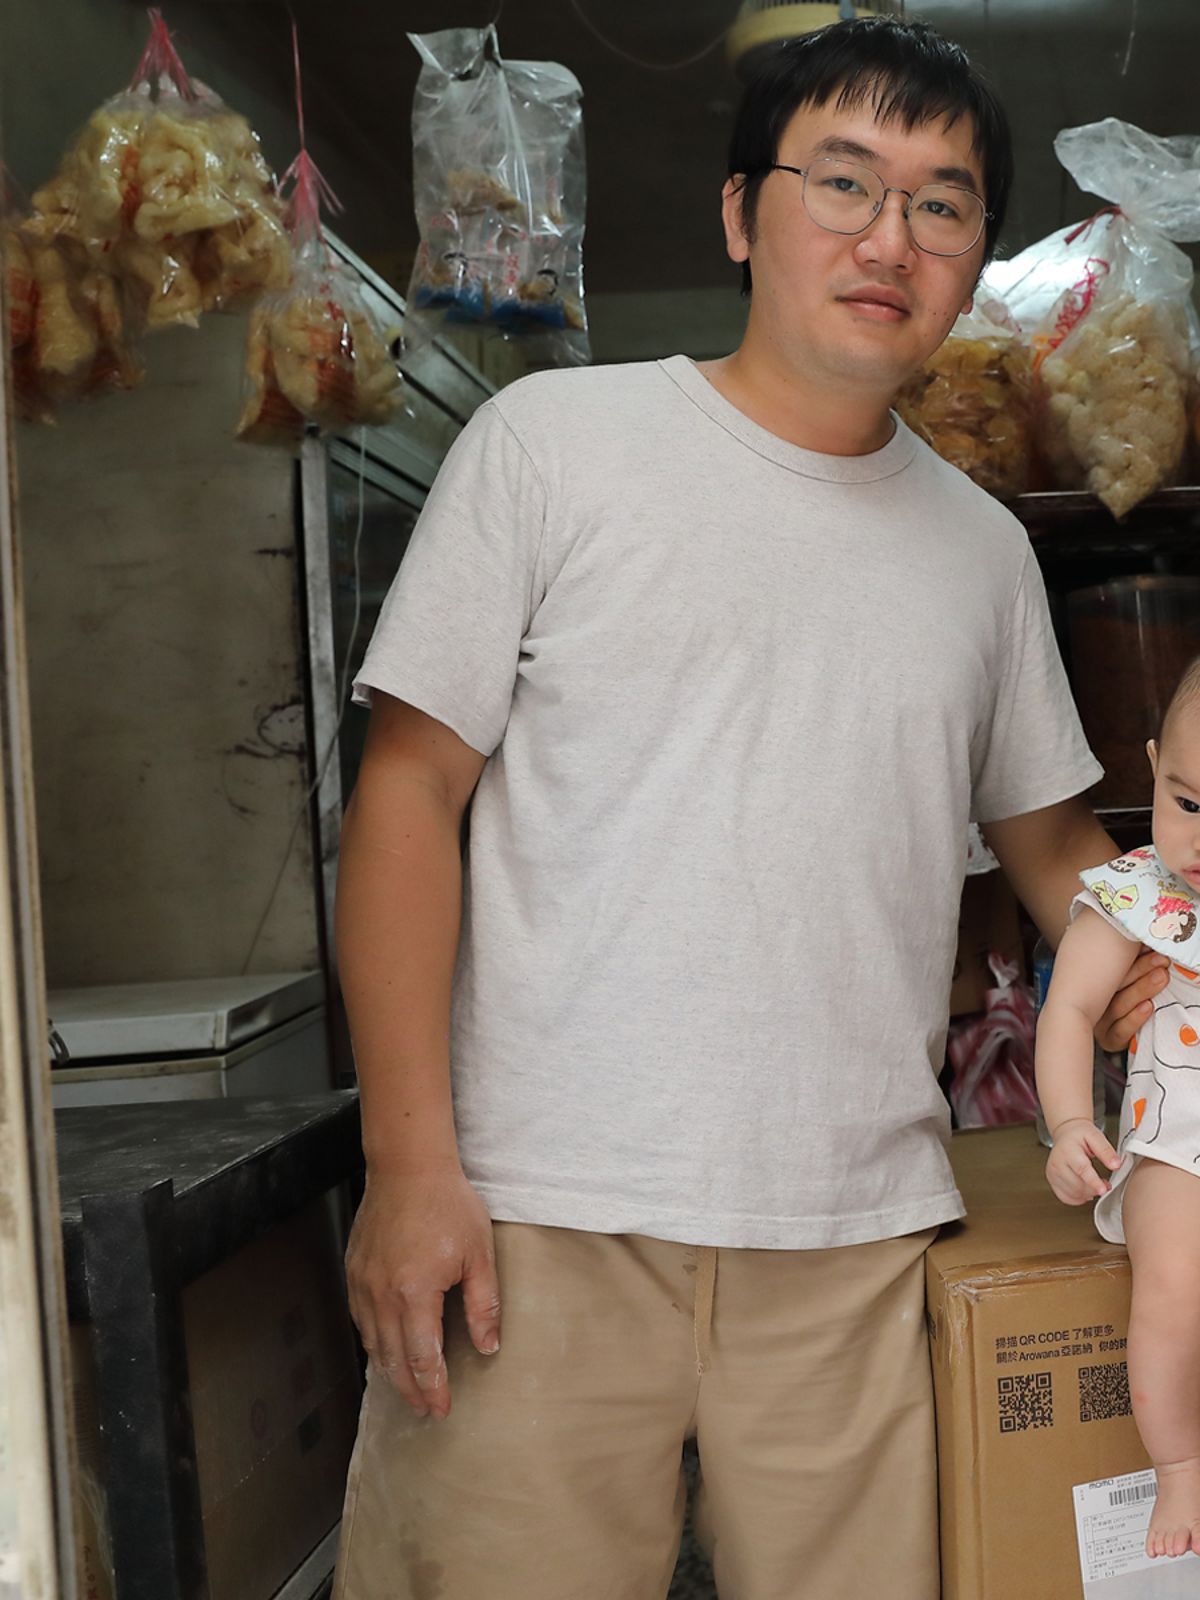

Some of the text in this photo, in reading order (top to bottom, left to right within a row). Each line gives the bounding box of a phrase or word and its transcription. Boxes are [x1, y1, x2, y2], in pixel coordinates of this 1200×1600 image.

[1019, 1334, 1036, 1346] QR
[1038, 1330, 1070, 1344] CODE
[1071, 1324, 1115, 1341] 了解更多
[1018, 1348, 1060, 1362] Arowana
